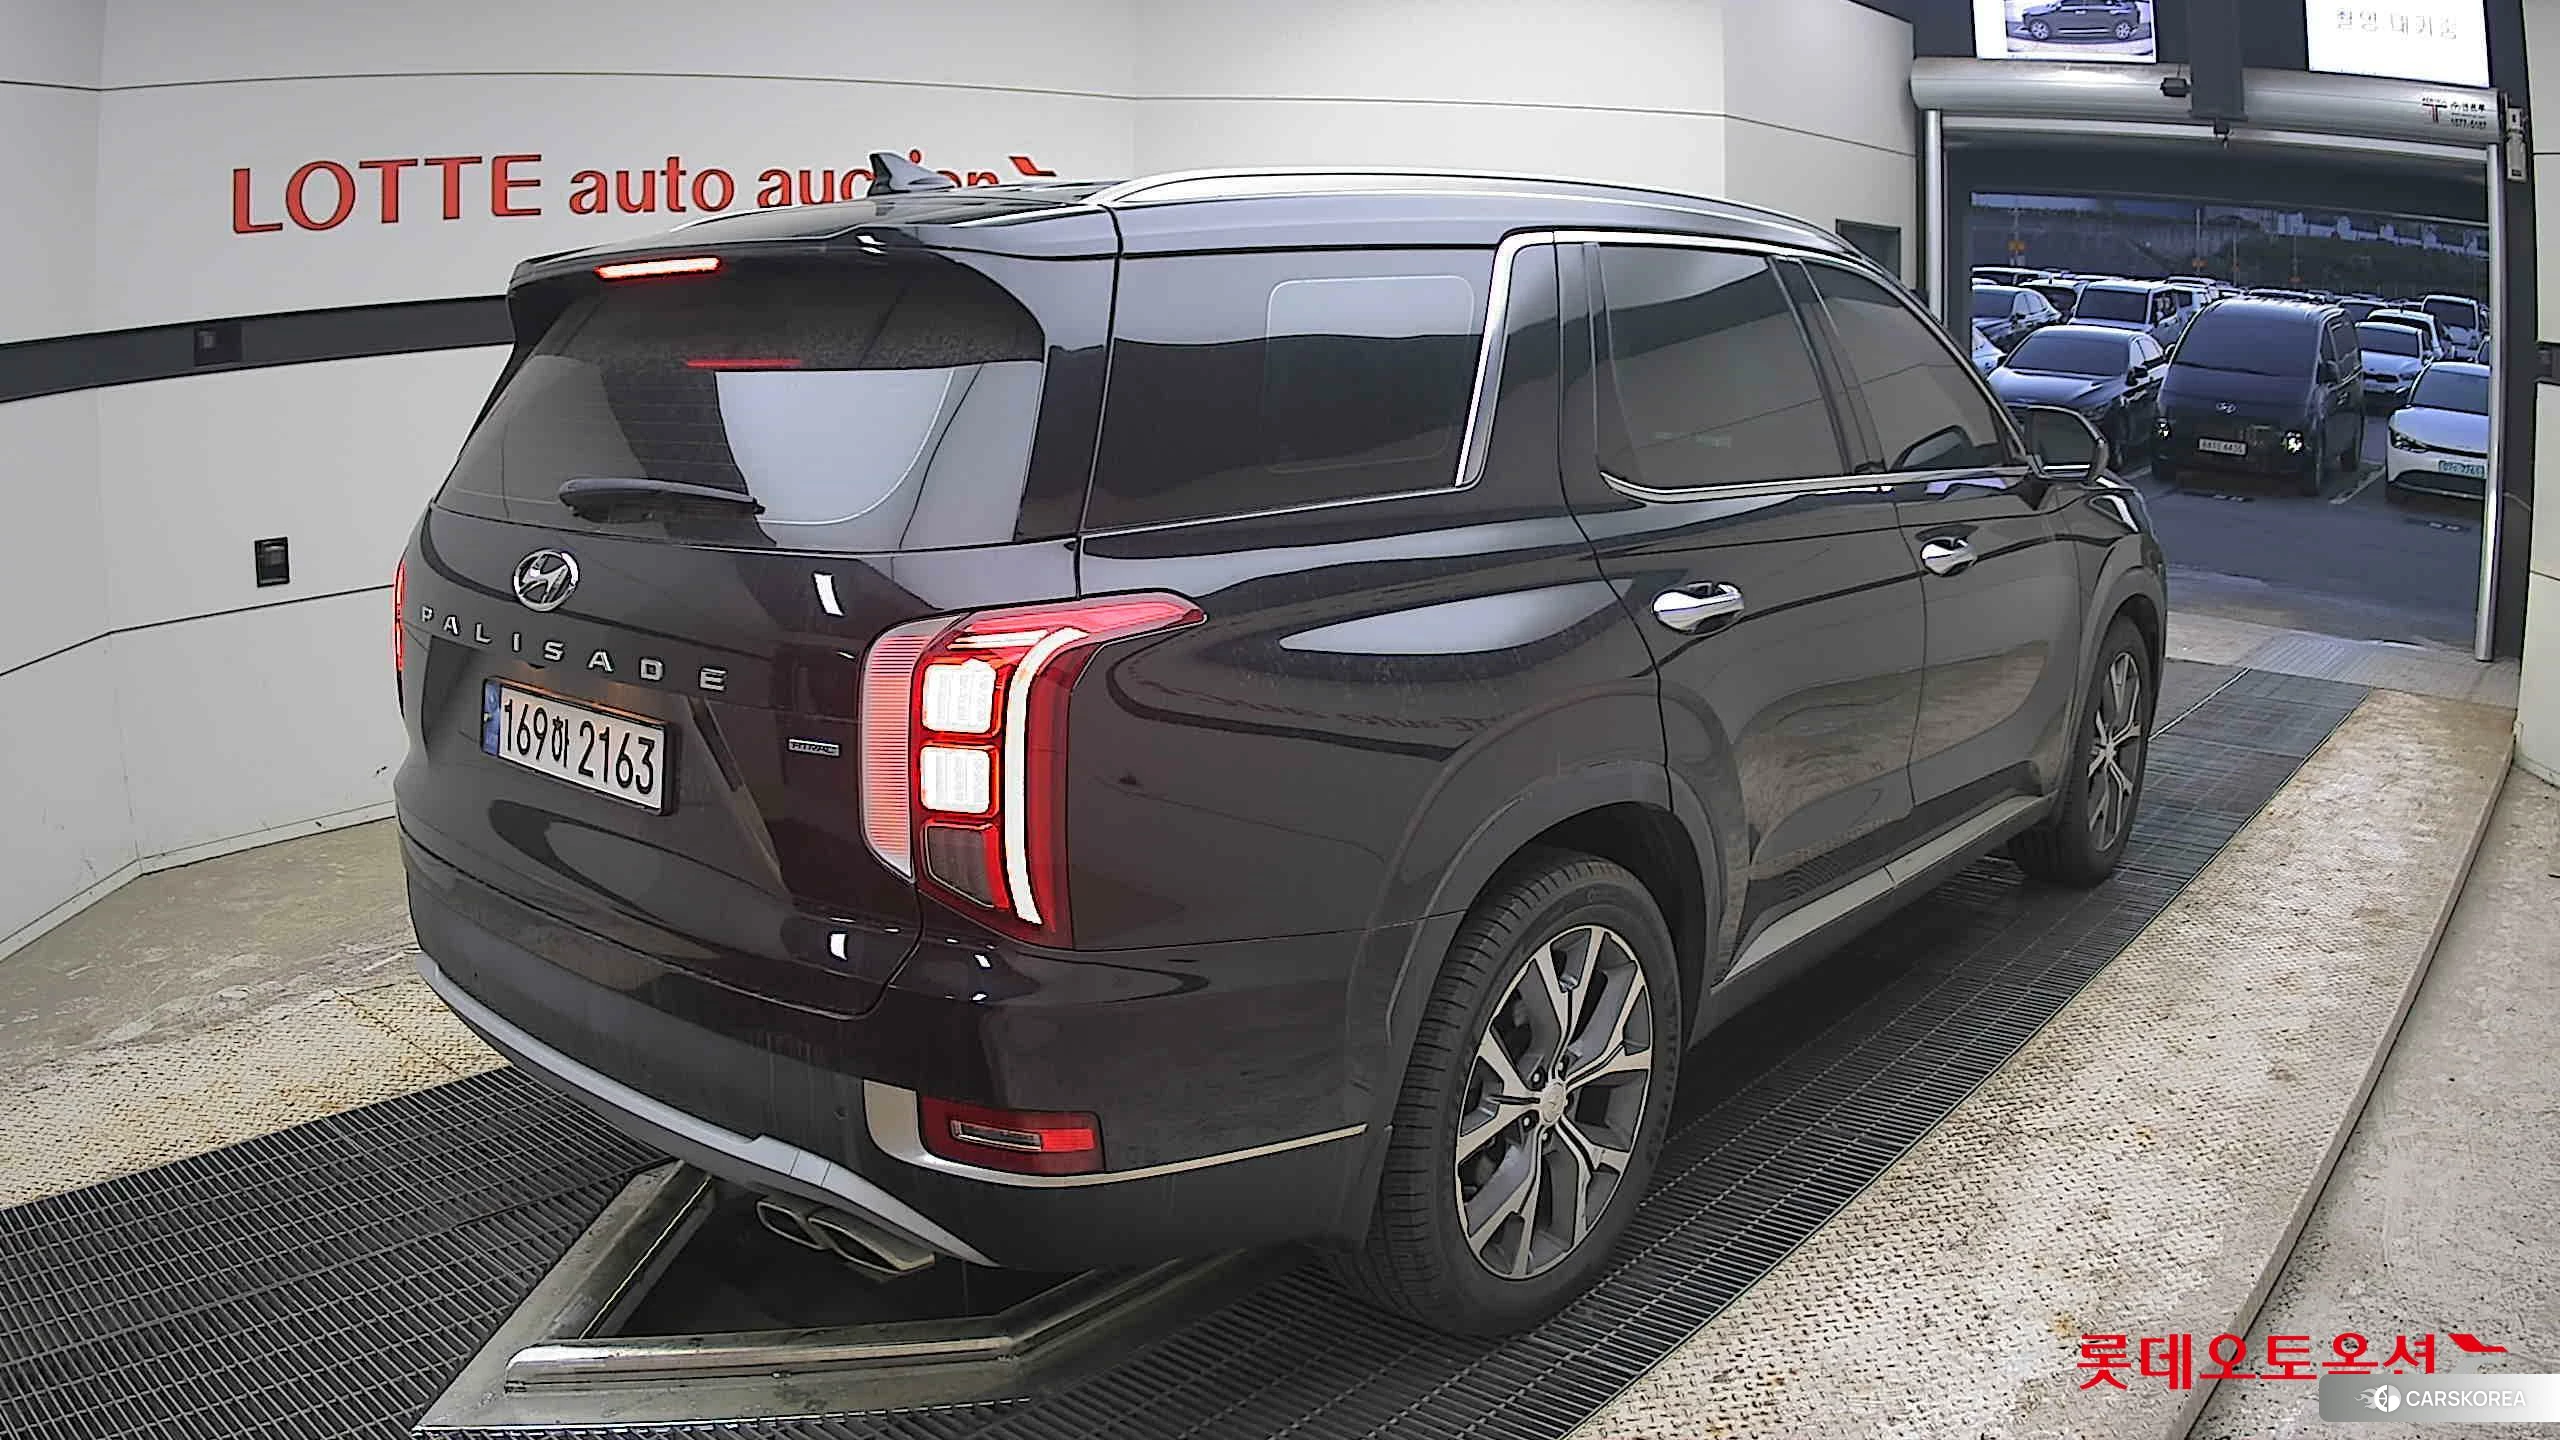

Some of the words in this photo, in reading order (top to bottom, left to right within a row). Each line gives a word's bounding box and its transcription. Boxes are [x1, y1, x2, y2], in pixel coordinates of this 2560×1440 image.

[233, 154, 542, 234] LOTTE
[569, 156, 735, 214] auto
[421, 607, 728, 692] PALISADE
[503, 698, 570, 769] 169하
[578, 720, 656, 796] 2163
